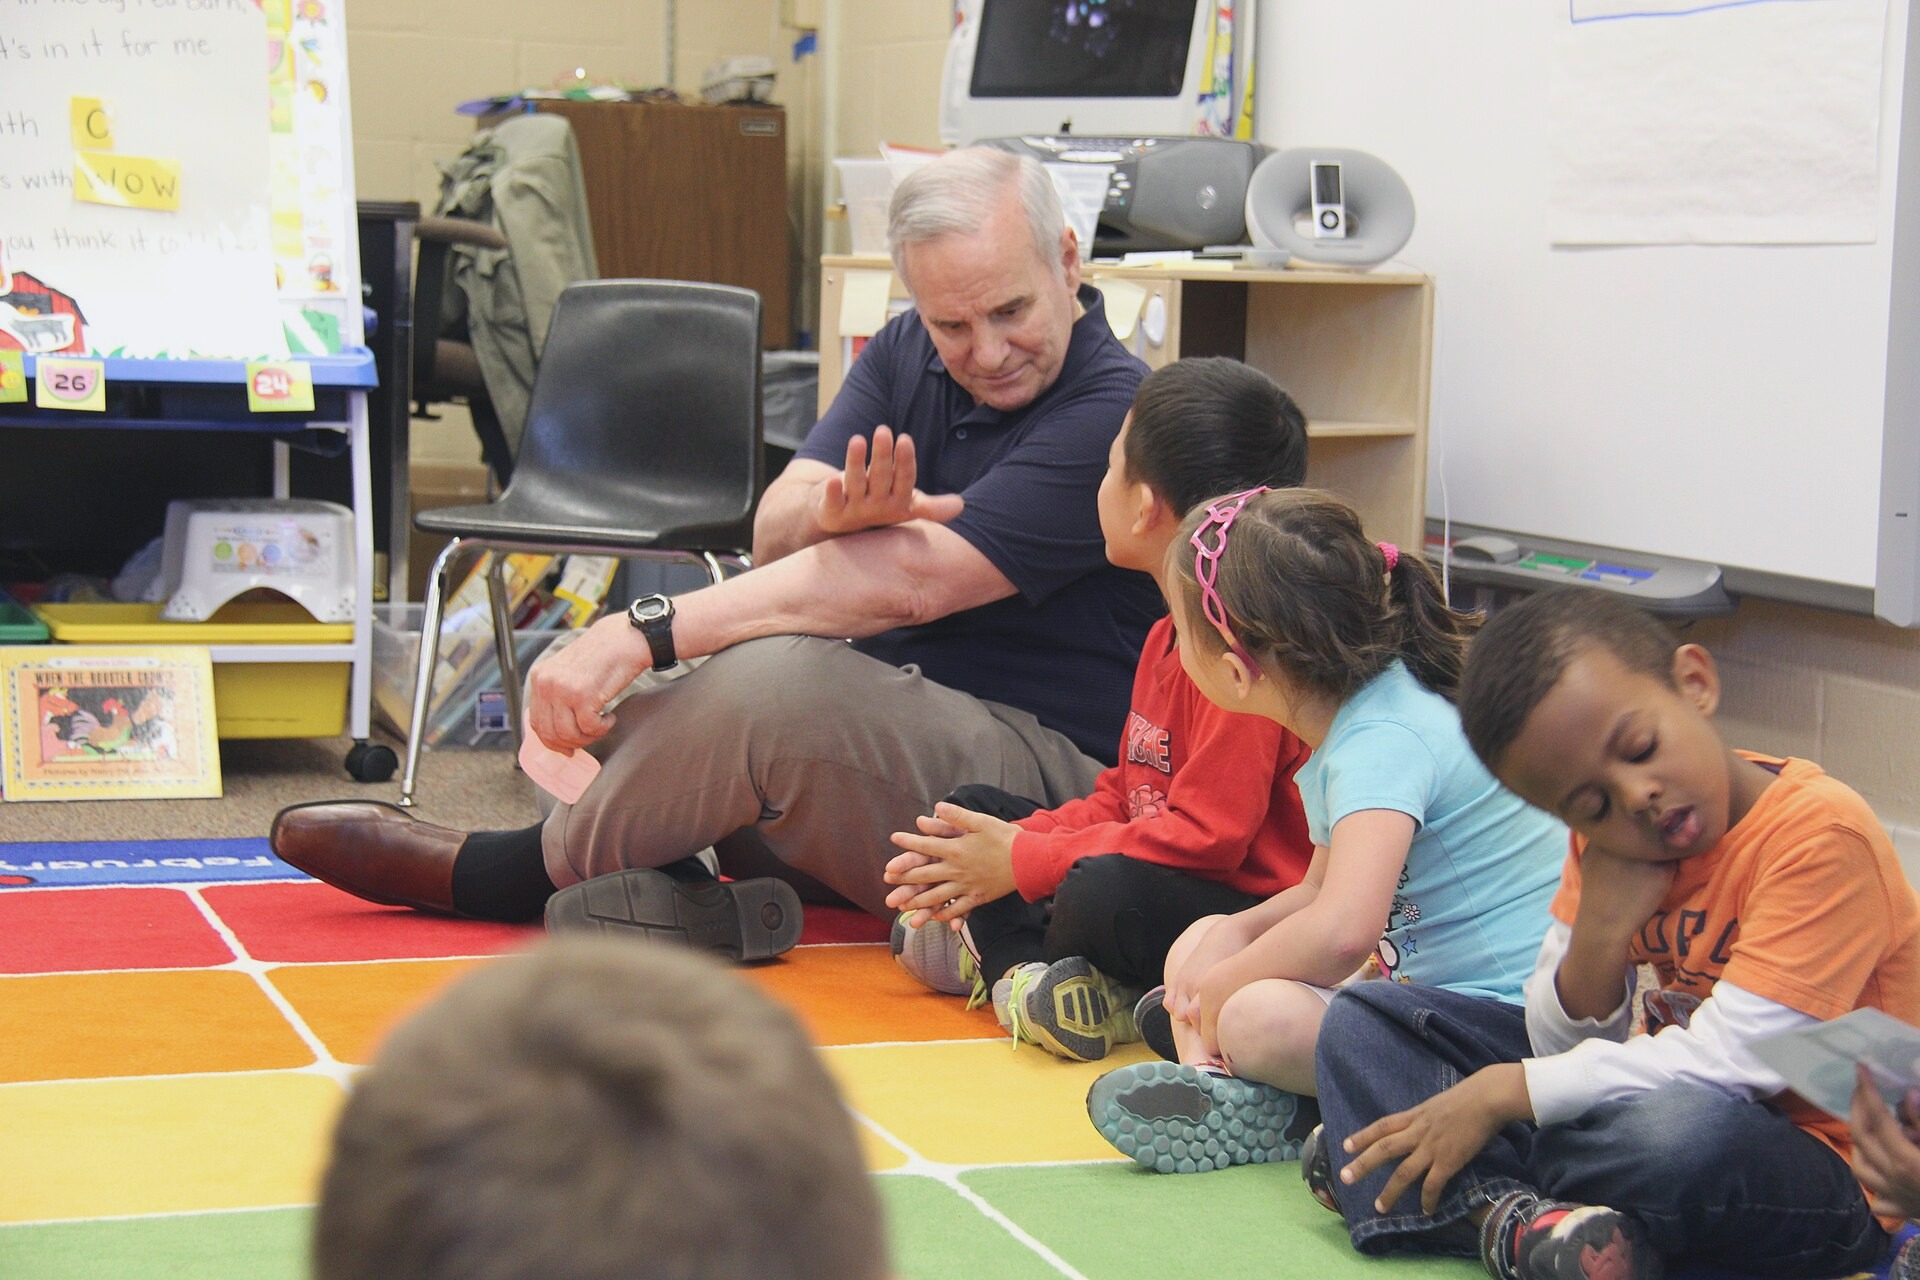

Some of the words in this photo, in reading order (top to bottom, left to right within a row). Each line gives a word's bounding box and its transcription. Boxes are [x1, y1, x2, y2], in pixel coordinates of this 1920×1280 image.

[43, 43, 69, 59] in
[82, 27, 103, 57] it
[121, 28, 158, 57] for
[174, 38, 214, 56] me
[22, 168, 73, 190] with
[51, 227, 117, 249] think
[129, 226, 147, 250] it
[54, 374, 86, 391] 26
[256, 375, 290, 395] 24
[35, 672, 63, 684] WHEN
[67, 672, 84, 684] THE
